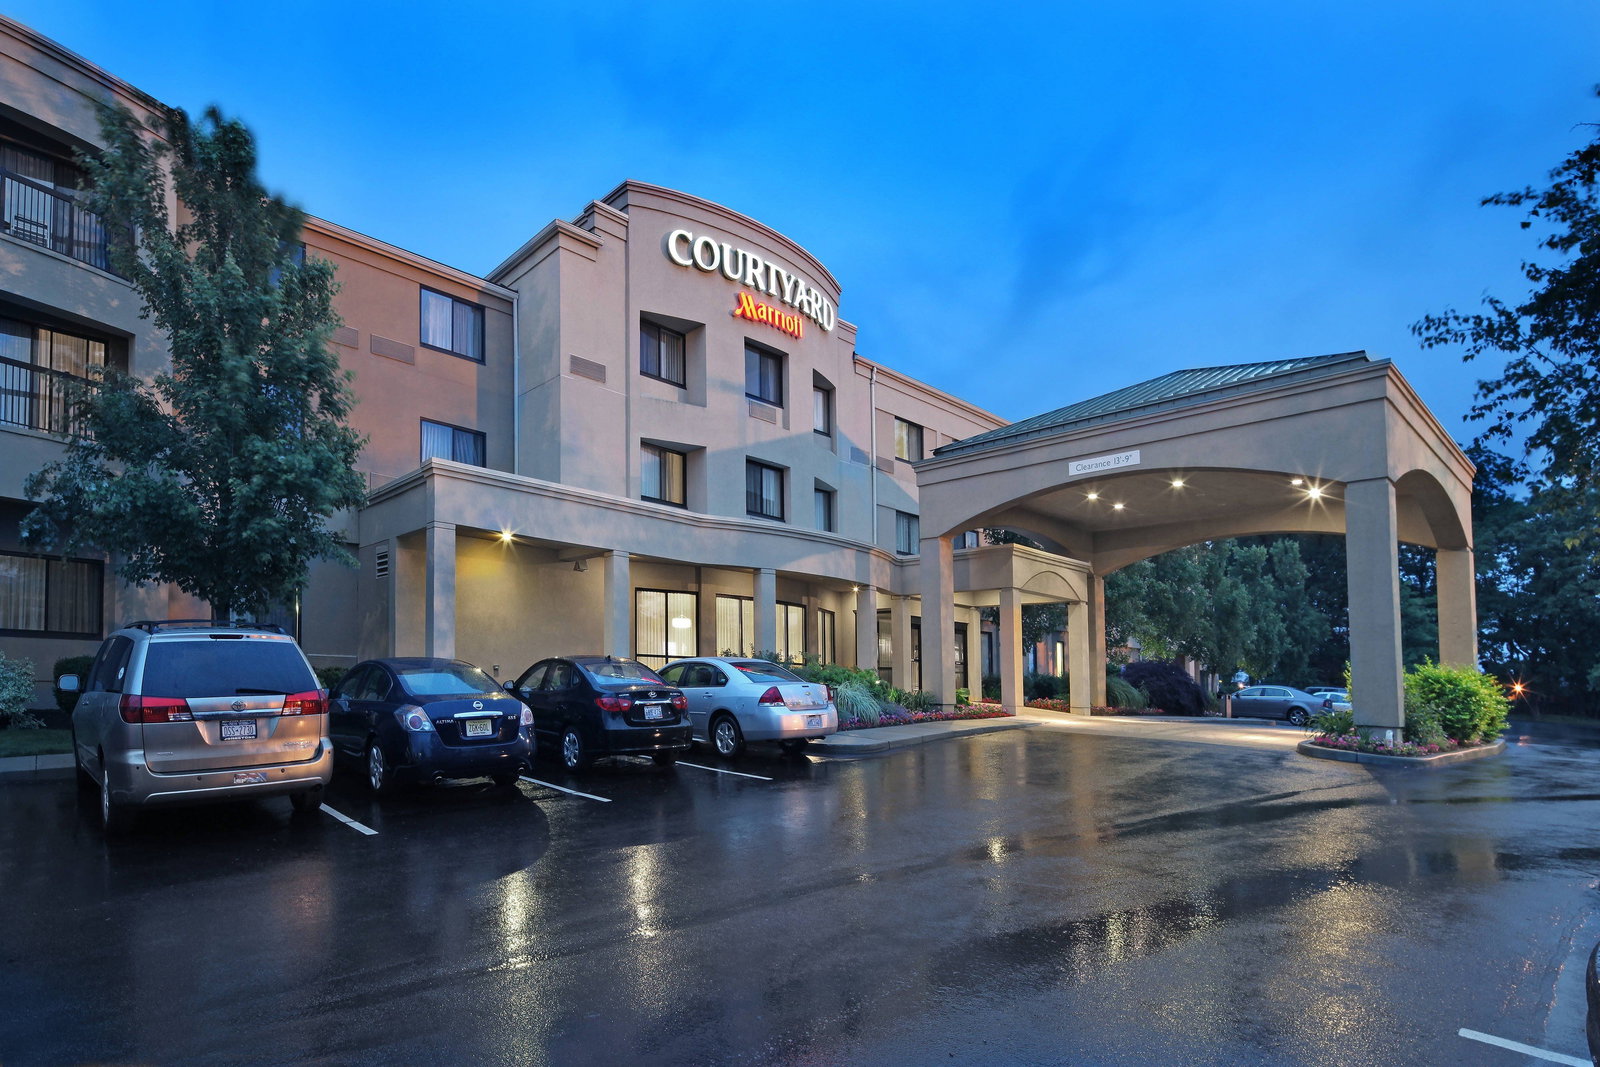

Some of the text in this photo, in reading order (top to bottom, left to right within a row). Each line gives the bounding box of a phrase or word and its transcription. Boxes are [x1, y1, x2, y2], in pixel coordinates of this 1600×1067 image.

[667, 228, 835, 332] COURTYARD
[734, 290, 804, 338] Marriott
[1075, 460, 1111, 472] Clearance
